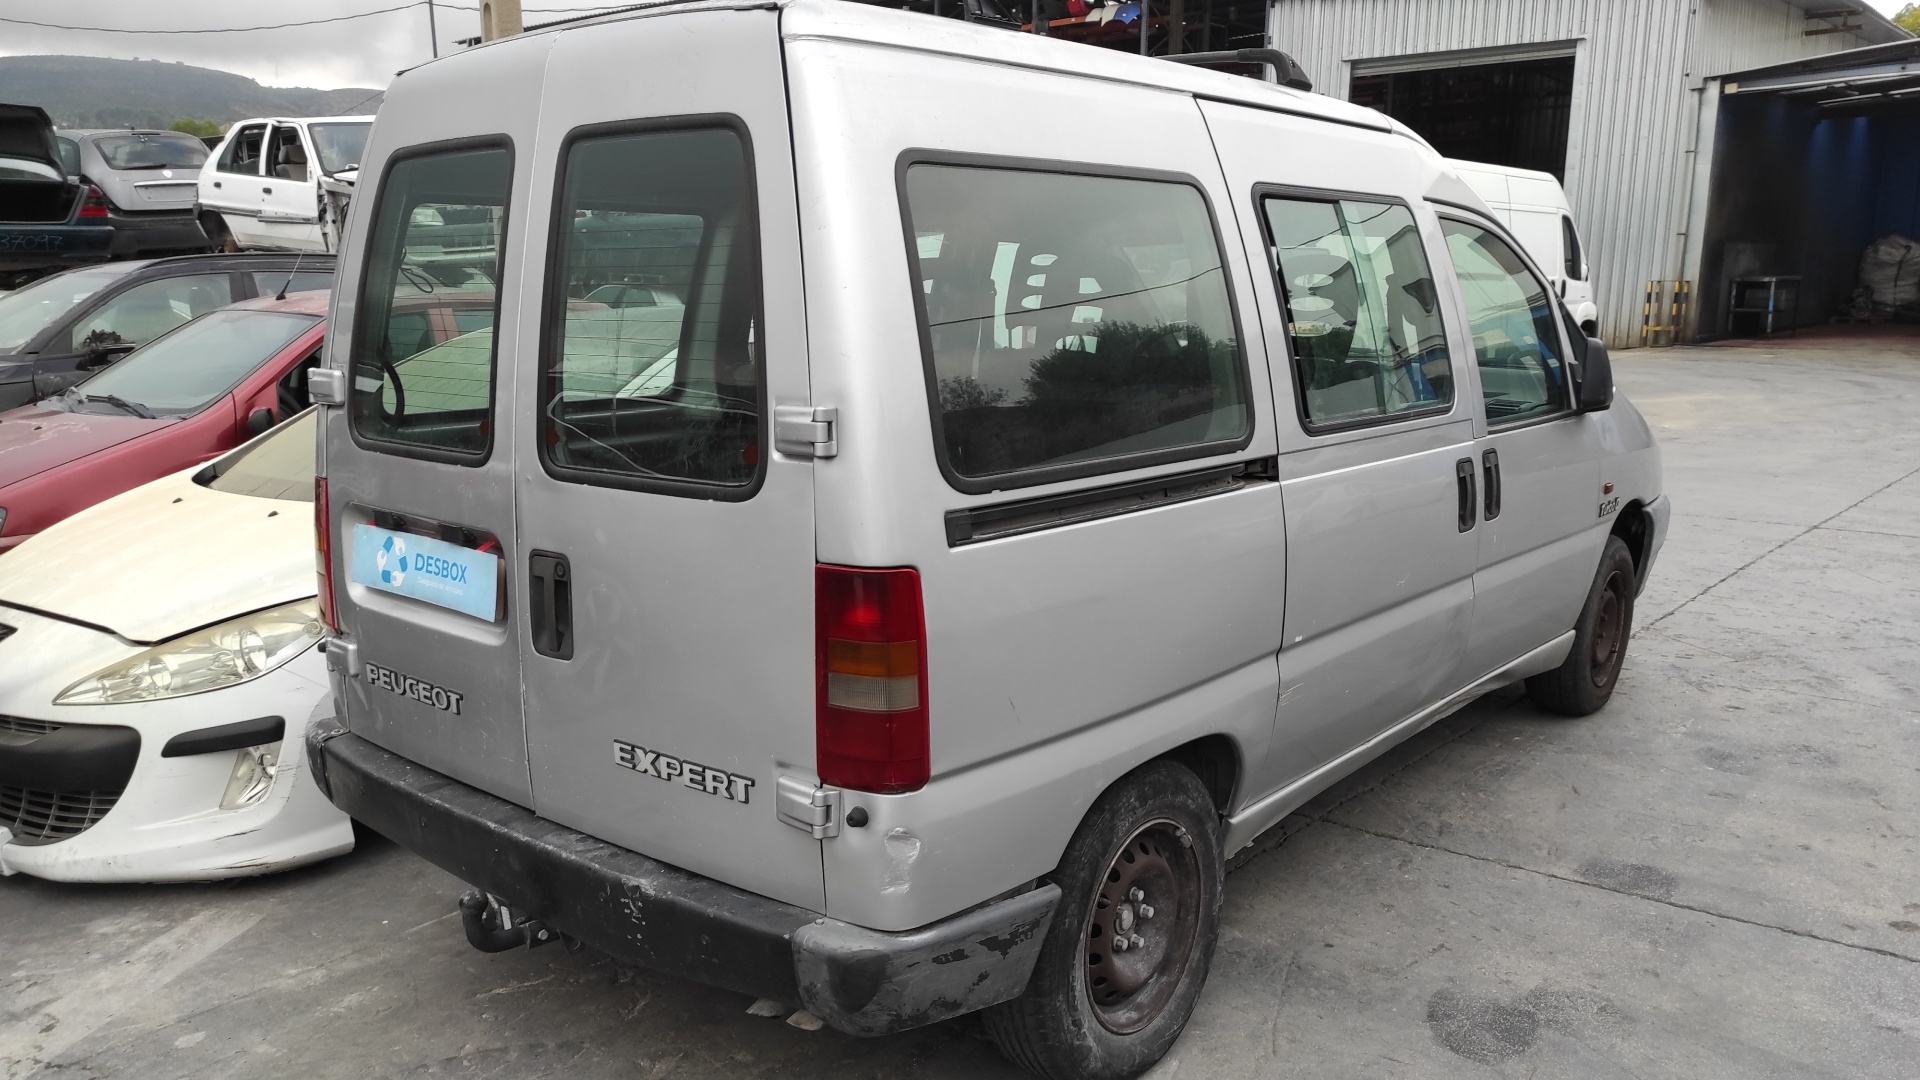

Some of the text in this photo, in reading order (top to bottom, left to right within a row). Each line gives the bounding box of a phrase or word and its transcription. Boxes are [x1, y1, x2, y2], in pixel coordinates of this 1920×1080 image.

[414, 553, 468, 584] DESBOX
[366, 661, 463, 715] PEUGEOT
[613, 738, 755, 804] EXPERT
